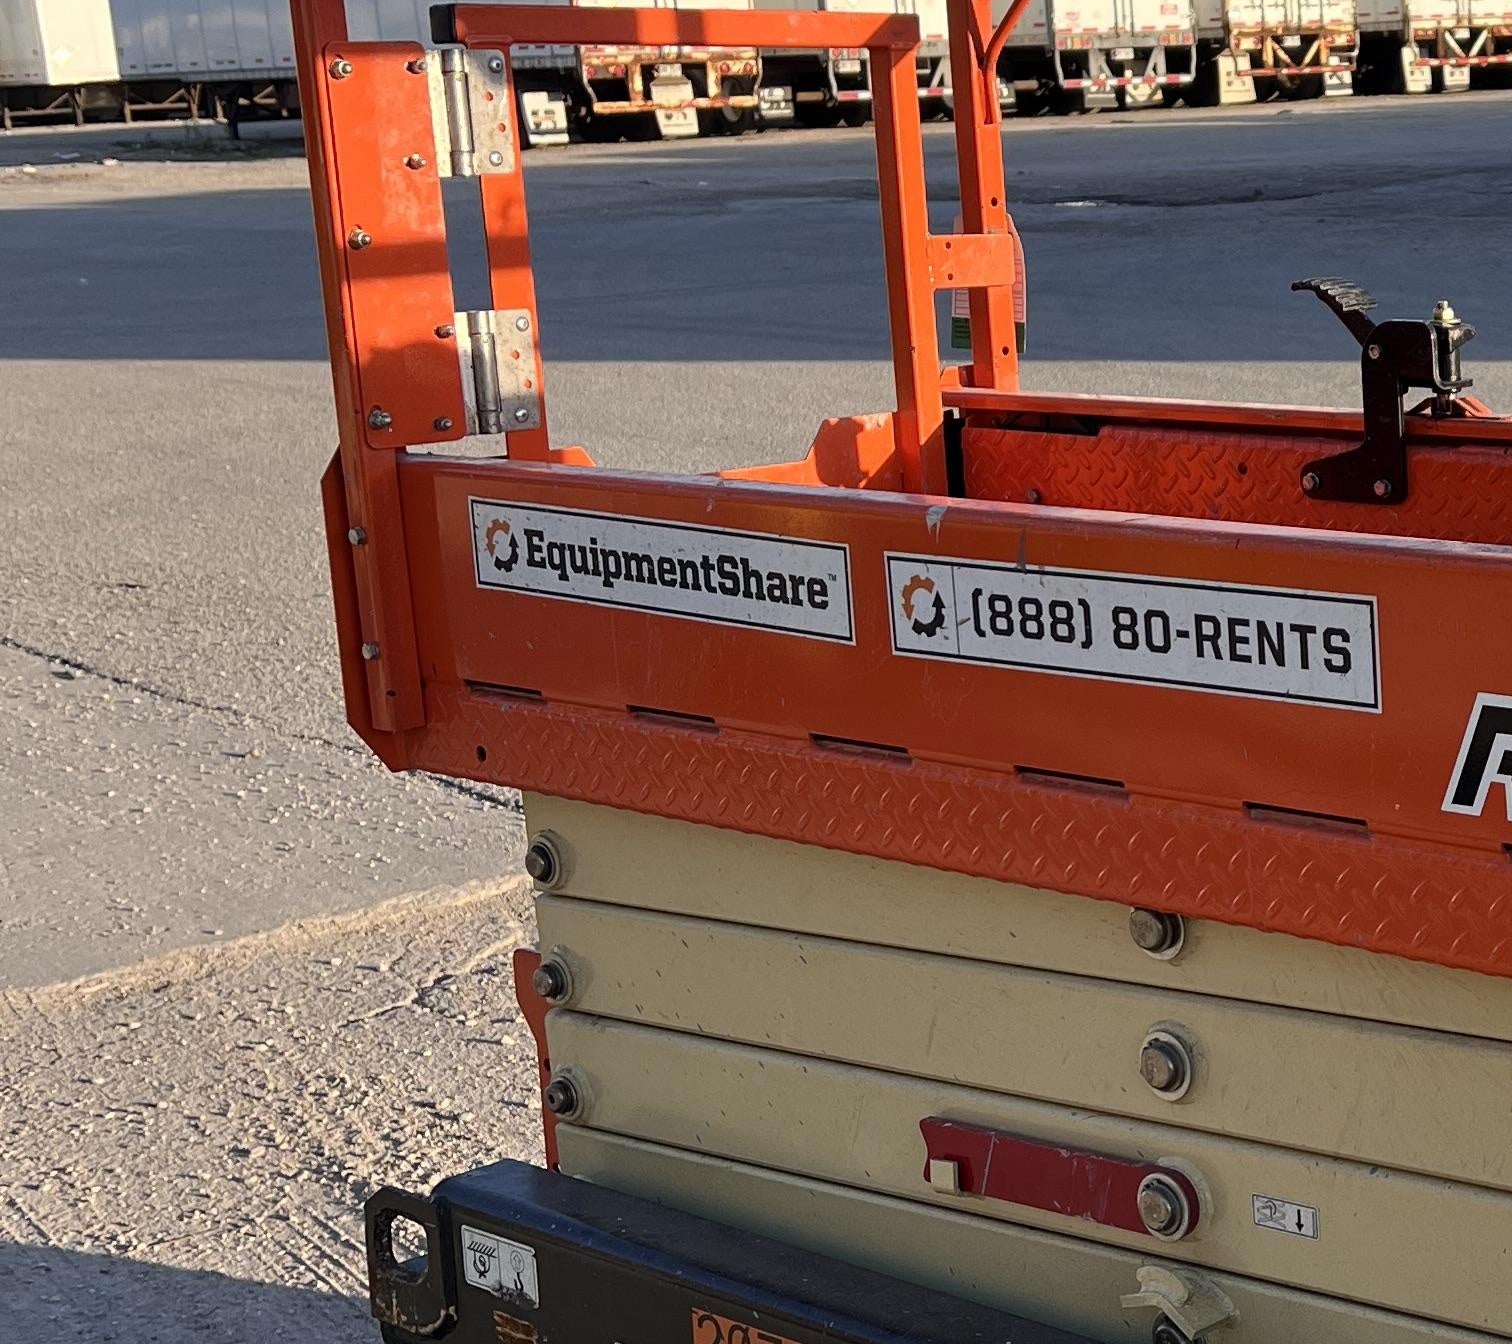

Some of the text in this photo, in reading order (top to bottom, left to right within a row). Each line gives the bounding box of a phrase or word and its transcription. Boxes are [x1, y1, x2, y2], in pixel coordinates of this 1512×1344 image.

[524, 528, 829, 610] EquipmentShare
[971, 586, 1353, 675] (888) 80-RENTS
